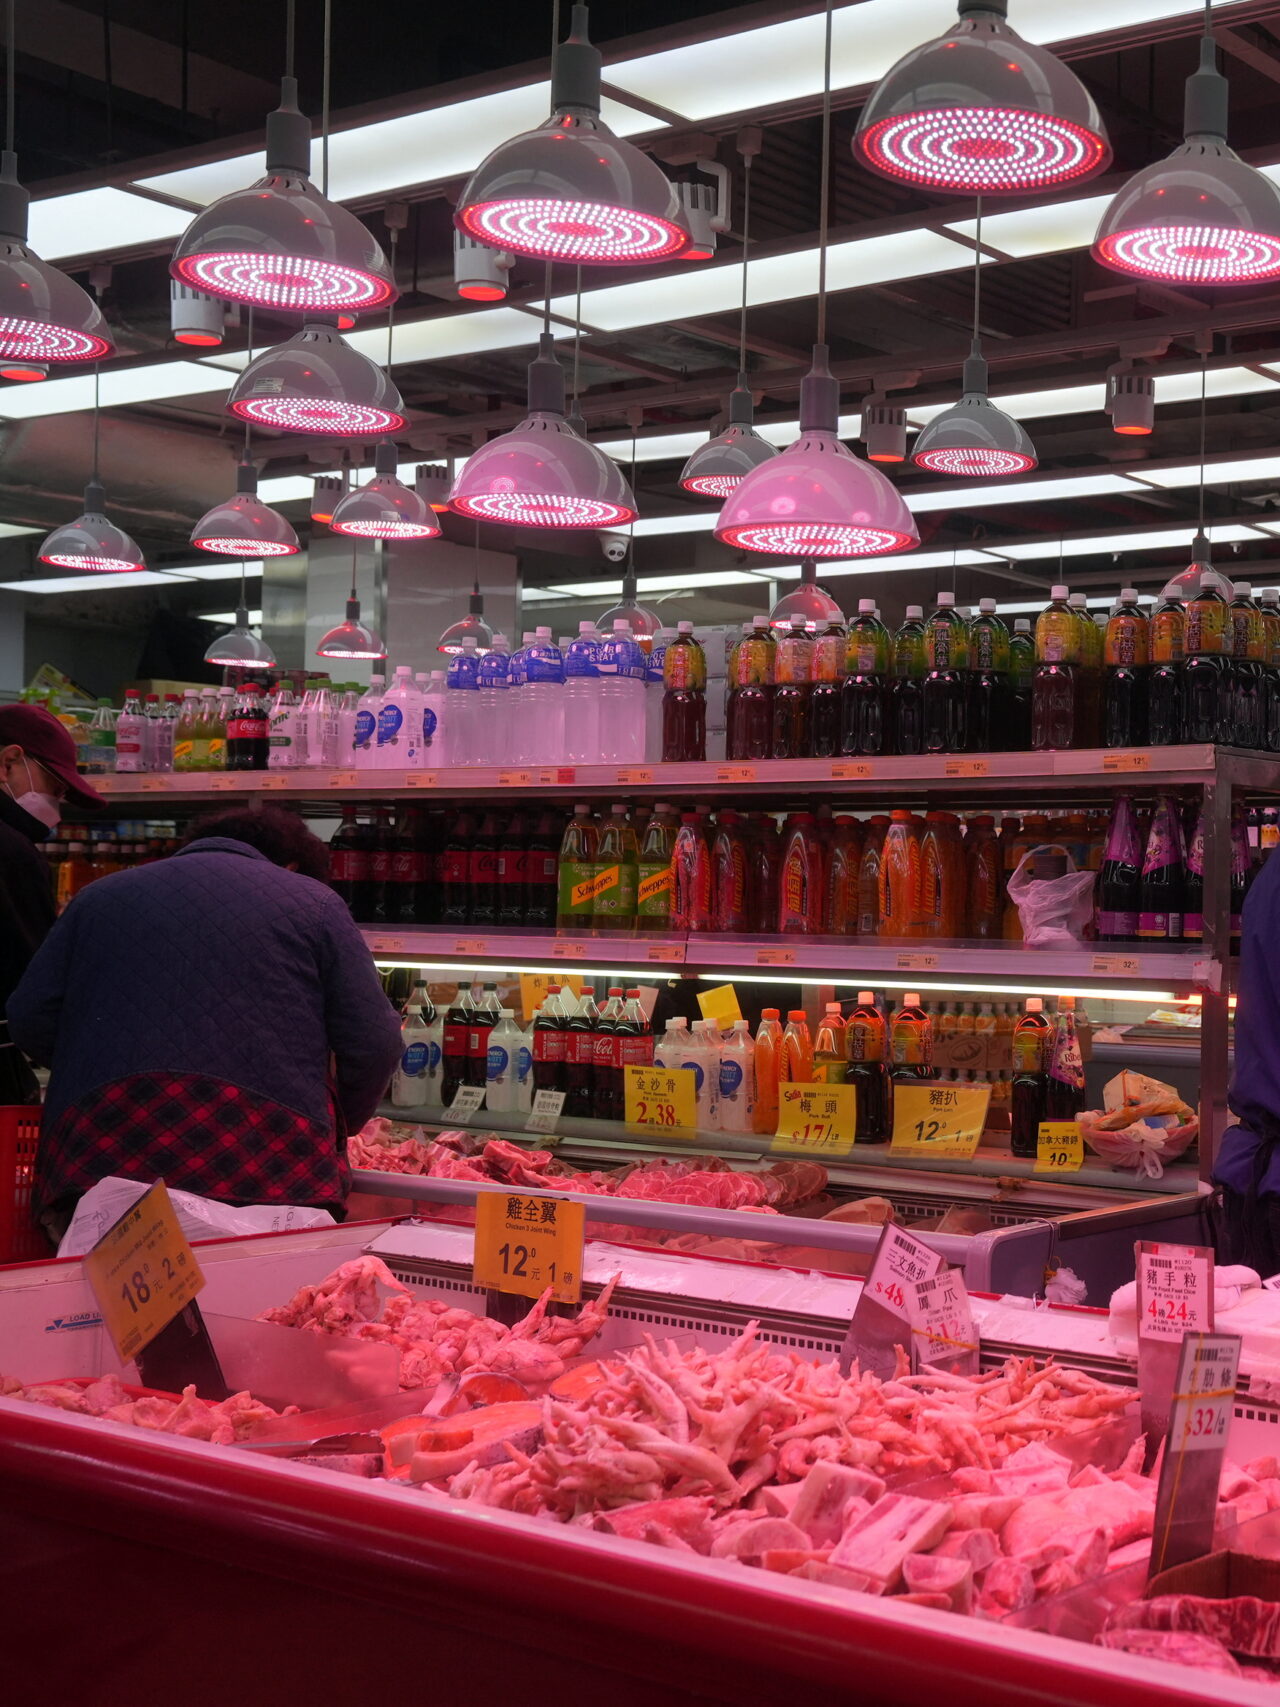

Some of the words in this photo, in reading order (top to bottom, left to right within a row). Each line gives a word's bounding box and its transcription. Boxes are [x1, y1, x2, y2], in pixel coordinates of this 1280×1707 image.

[635, 1075, 676, 1094] 金沙骨
[799, 1098, 838, 1115] 梅頭
[928, 1089, 958, 1106] 豬扒
[505, 1196, 558, 1225] 雞全翼
[505, 1222, 525, 1232] Chicken
[530, 1226, 543, 1234] Joint
[543, 1228, 557, 1237] Wing
[885, 1247, 927, 1281] 三文魚扒
[1146, 1268, 1197, 1288] 豬手粒
[69, 1312, 90, 1323] LOAD
